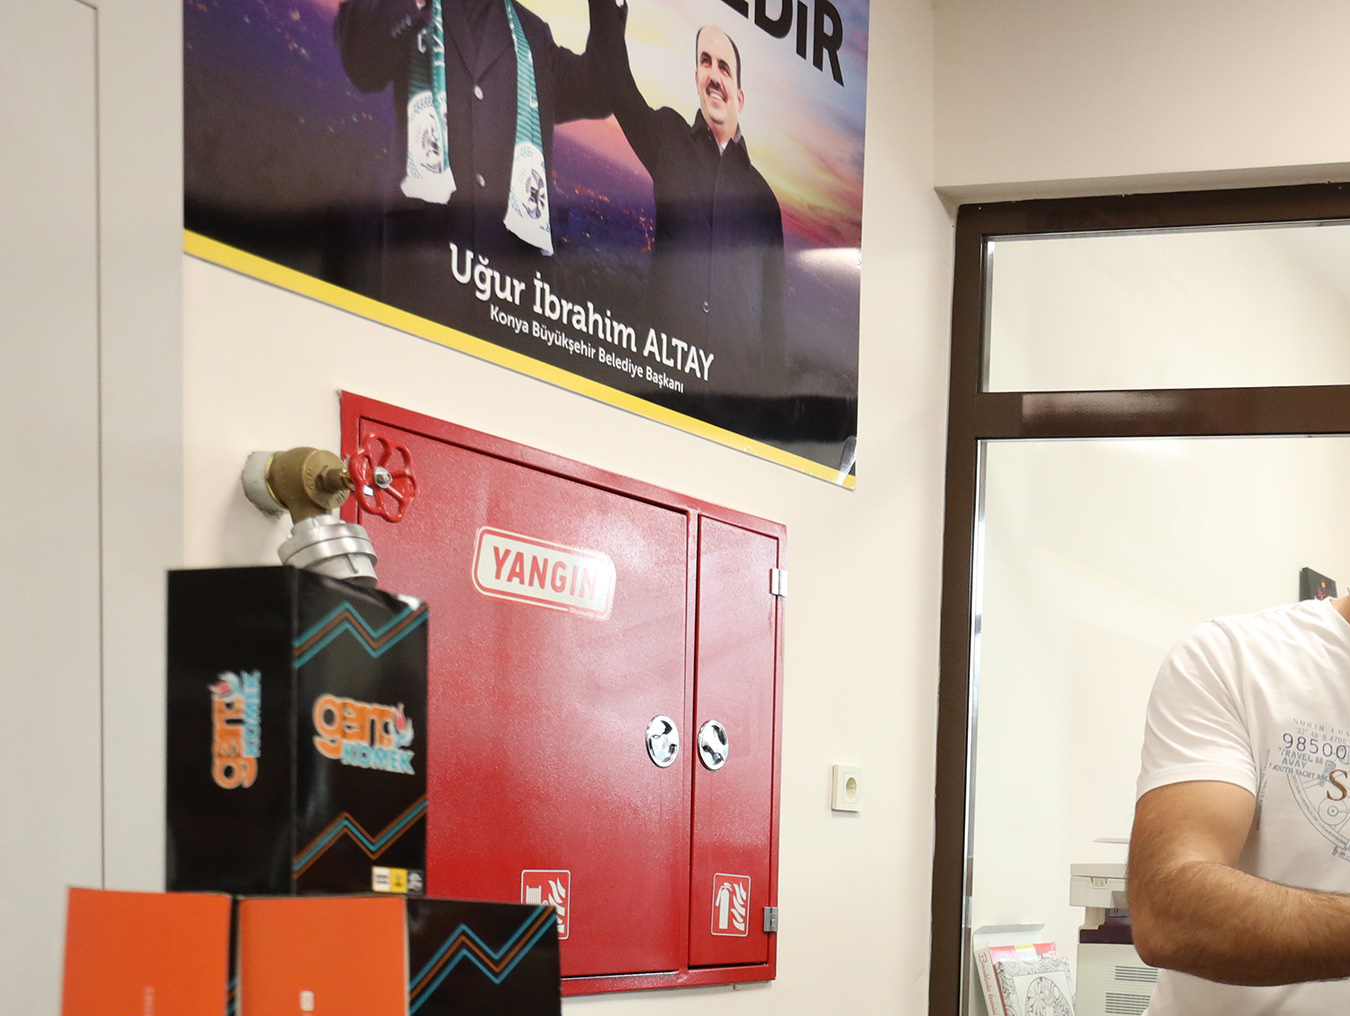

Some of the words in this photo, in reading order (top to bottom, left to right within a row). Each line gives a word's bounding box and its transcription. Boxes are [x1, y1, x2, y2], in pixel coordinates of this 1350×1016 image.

[449, 241, 525, 305] Uğur
[533, 271, 637, 352] İbrahim
[643, 328, 714, 381] ALTAY
[490, 304, 529, 334] Konya
[532, 321, 596, 359] Büyükşehir
[598, 347, 644, 378] Belediye
[646, 366, 684, 394] Başkanı
[493, 546, 596, 600] YANGIN
[341, 739, 416, 775] KOMEK
